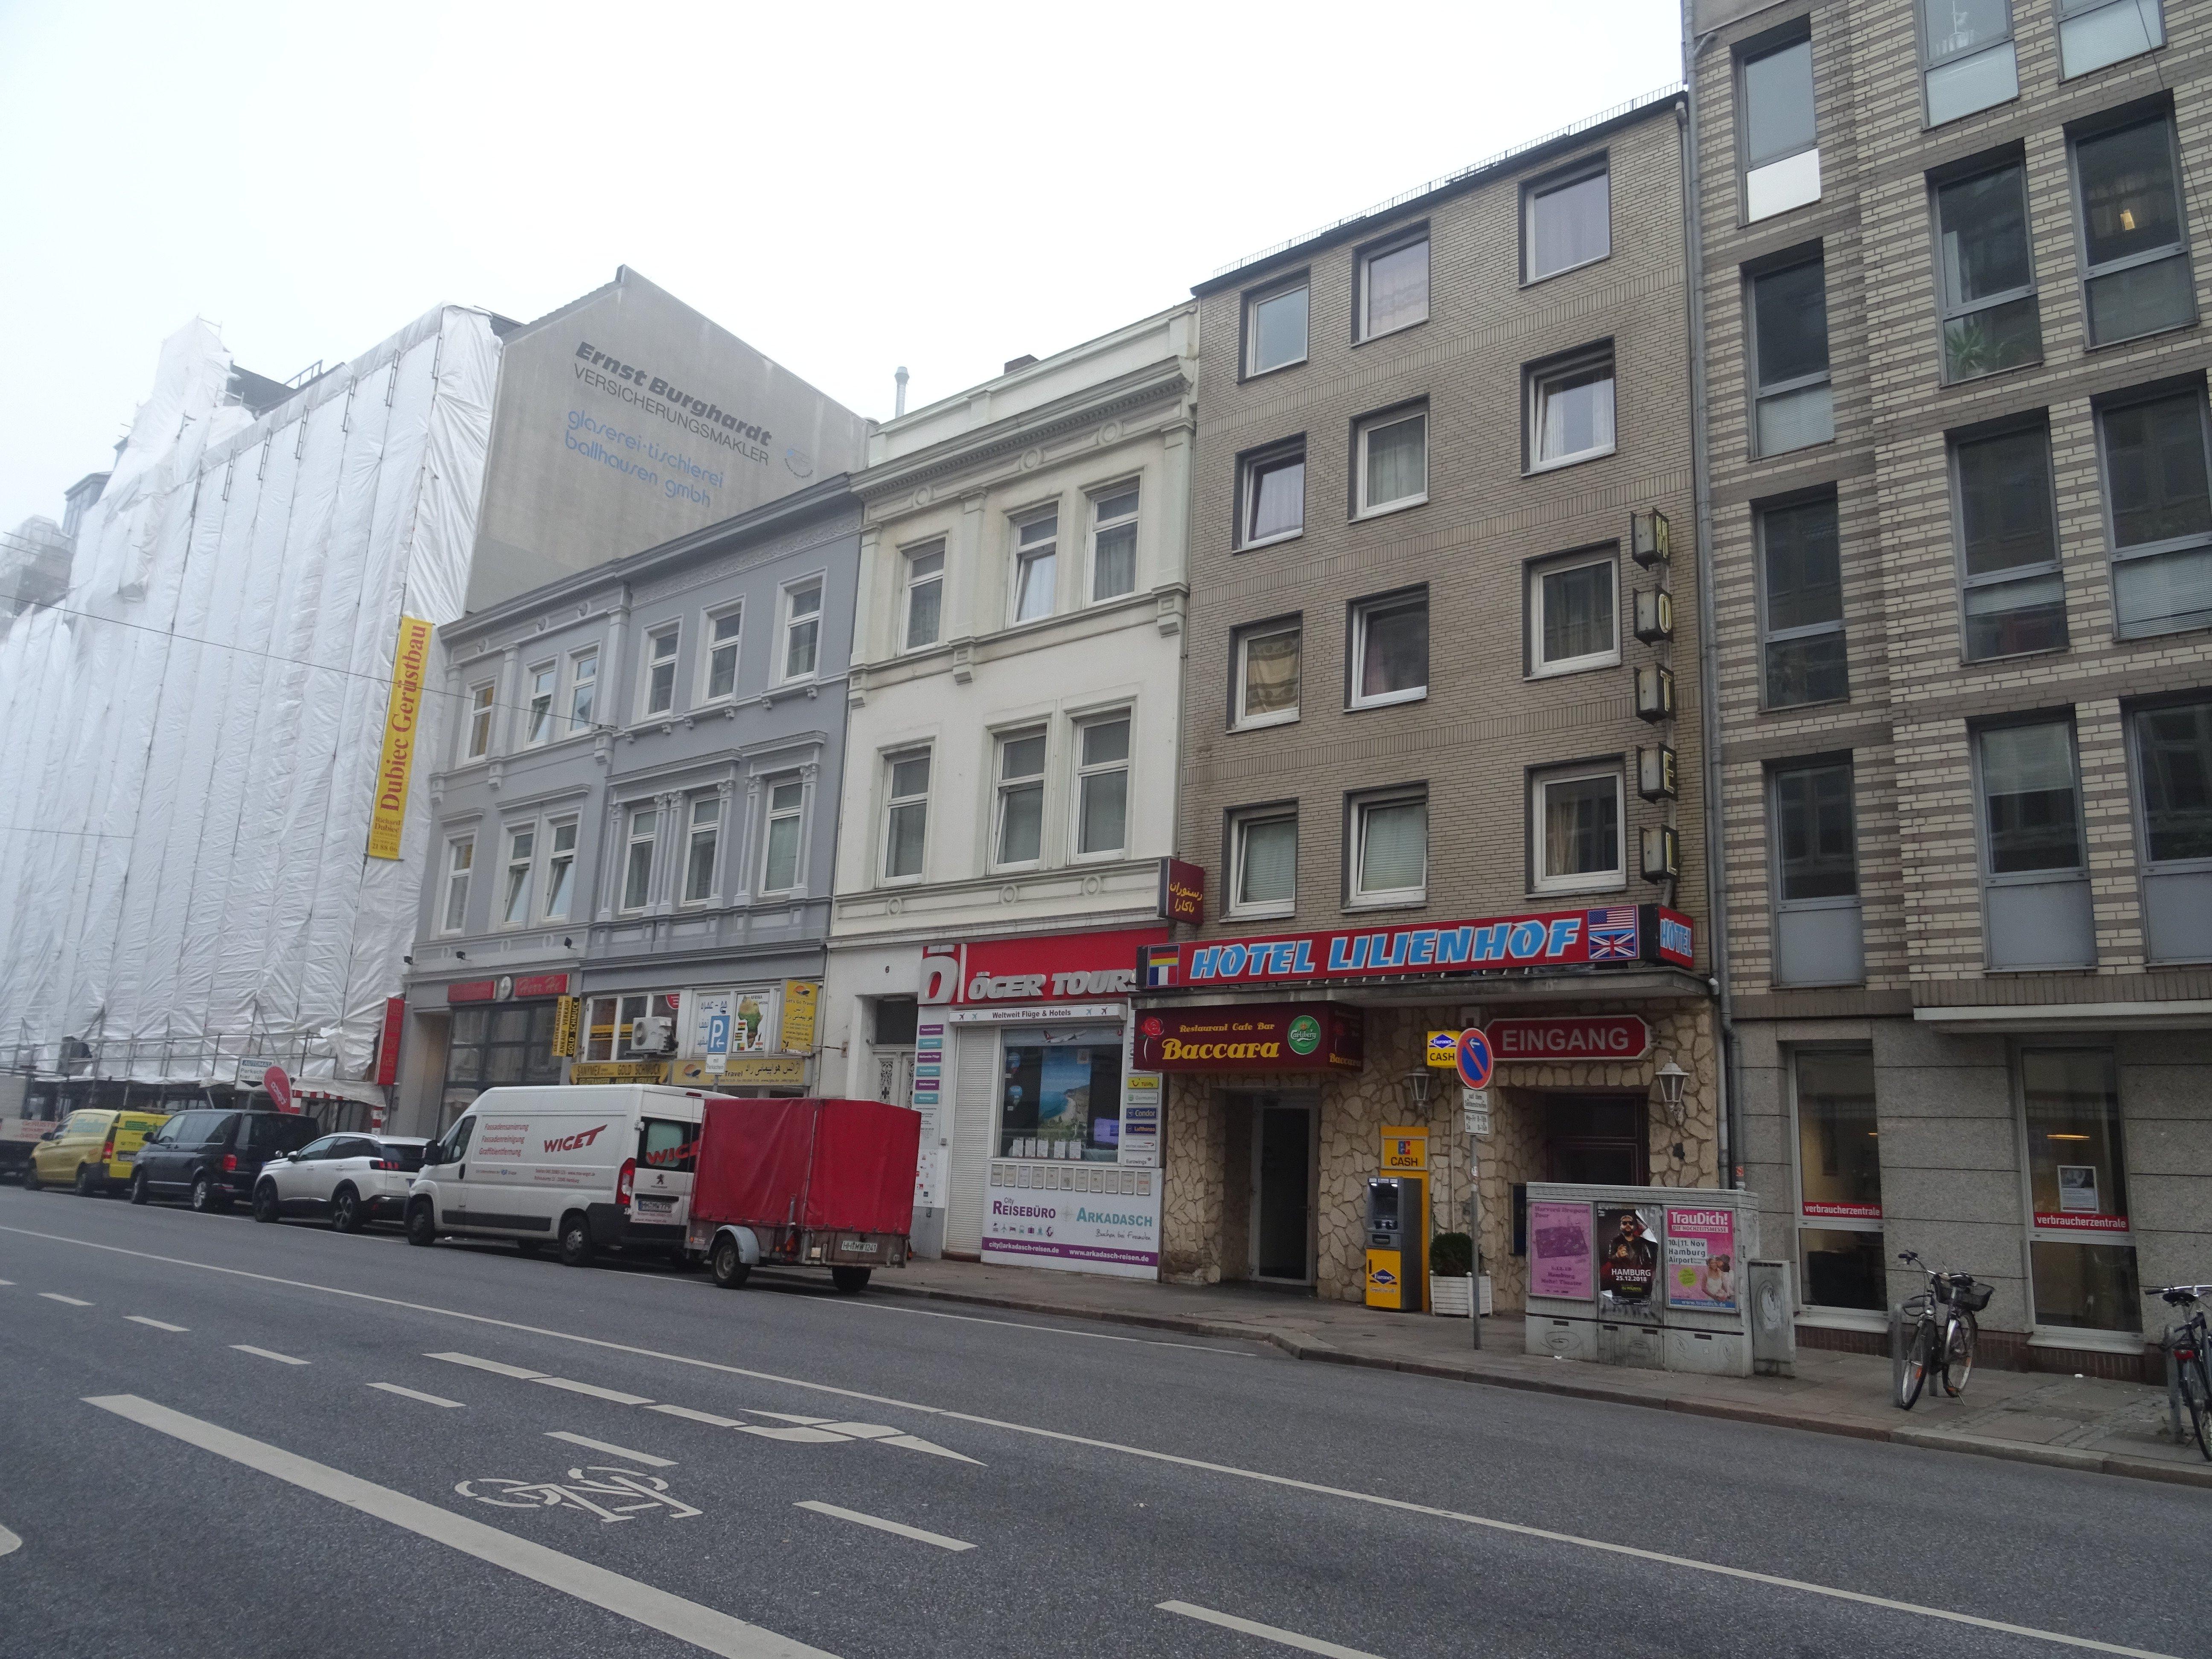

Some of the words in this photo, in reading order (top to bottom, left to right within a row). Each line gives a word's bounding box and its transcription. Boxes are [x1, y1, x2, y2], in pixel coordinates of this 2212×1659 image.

[576, 341, 647, 387] Ernst
[648, 376, 772, 446] Burghardt
[574, 363, 769, 466] VERSICHERUNGSMAKLER
[565, 431, 658, 486] ballhausen
[664, 478, 711, 508] gmbh
[391, 624, 426, 733] Gerüstbau
[380, 738, 408, 812] Dubiec
[1170, 882, 1203, 901] رستوران
[1659, 916, 1693, 957] HOTEL
[1189, 939, 1316, 980] HOTEL
[1327, 918, 1582, 971] LILIENHOF
[968, 971, 1047, 1001] ÖGER
[570, 1001, 579, 1033] SCHMUCK
[992, 1010, 1021, 1019] Weltweit
[1022, 1010, 1041, 1020] Flüge
[1049, 1009, 1072, 1017] Hotels
[710, 1020, 724, 1048] P
[1179, 1023, 1228, 1033] Restaurant
[1232, 1022, 1253, 1032] Cafe
[1257, 1022, 1275, 1030] Bar
[1290, 1028, 1317, 1041] Carlsberg
[1502, 1027, 1630, 1052] EINGANG
[1161, 1037, 1281, 1060] Baccara
[1429, 1052, 1455, 1062] CASH
[1135, 1109, 1156, 1117] Condor
[485, 1123, 530, 1132] Fassadensanierung
[481, 1135, 525, 1144] Fassadenreinigung
[1391, 1157, 1418, 1167] CASH
[1004, 1196, 1014, 1205] City
[992, 1199, 1056, 1219] REISEBÜRO
[1804, 1203, 1880, 1217] verbraucherzentrale
[1076, 1207, 1153, 1227] ARKADASCH
[1671, 1211, 1729, 1226] TrauDich!
[2036, 1214, 2127, 1229] verbraucherzentrale
[1117, 1229, 1125, 1239] bei
[989, 1241, 1059, 1254] city@arkadasch-reisen.de
[1069, 1249, 1150, 1262] www.arkadasch-reisen.de
[1690, 1240, 1706, 1248] Nov
[1668, 1248, 1706, 1257] Hamburg
[1668, 1256, 1694, 1264] Airport
[1548, 1272, 1576, 1280] Hamburg
[1611, 1268, 1651, 1277] HAMBURG
